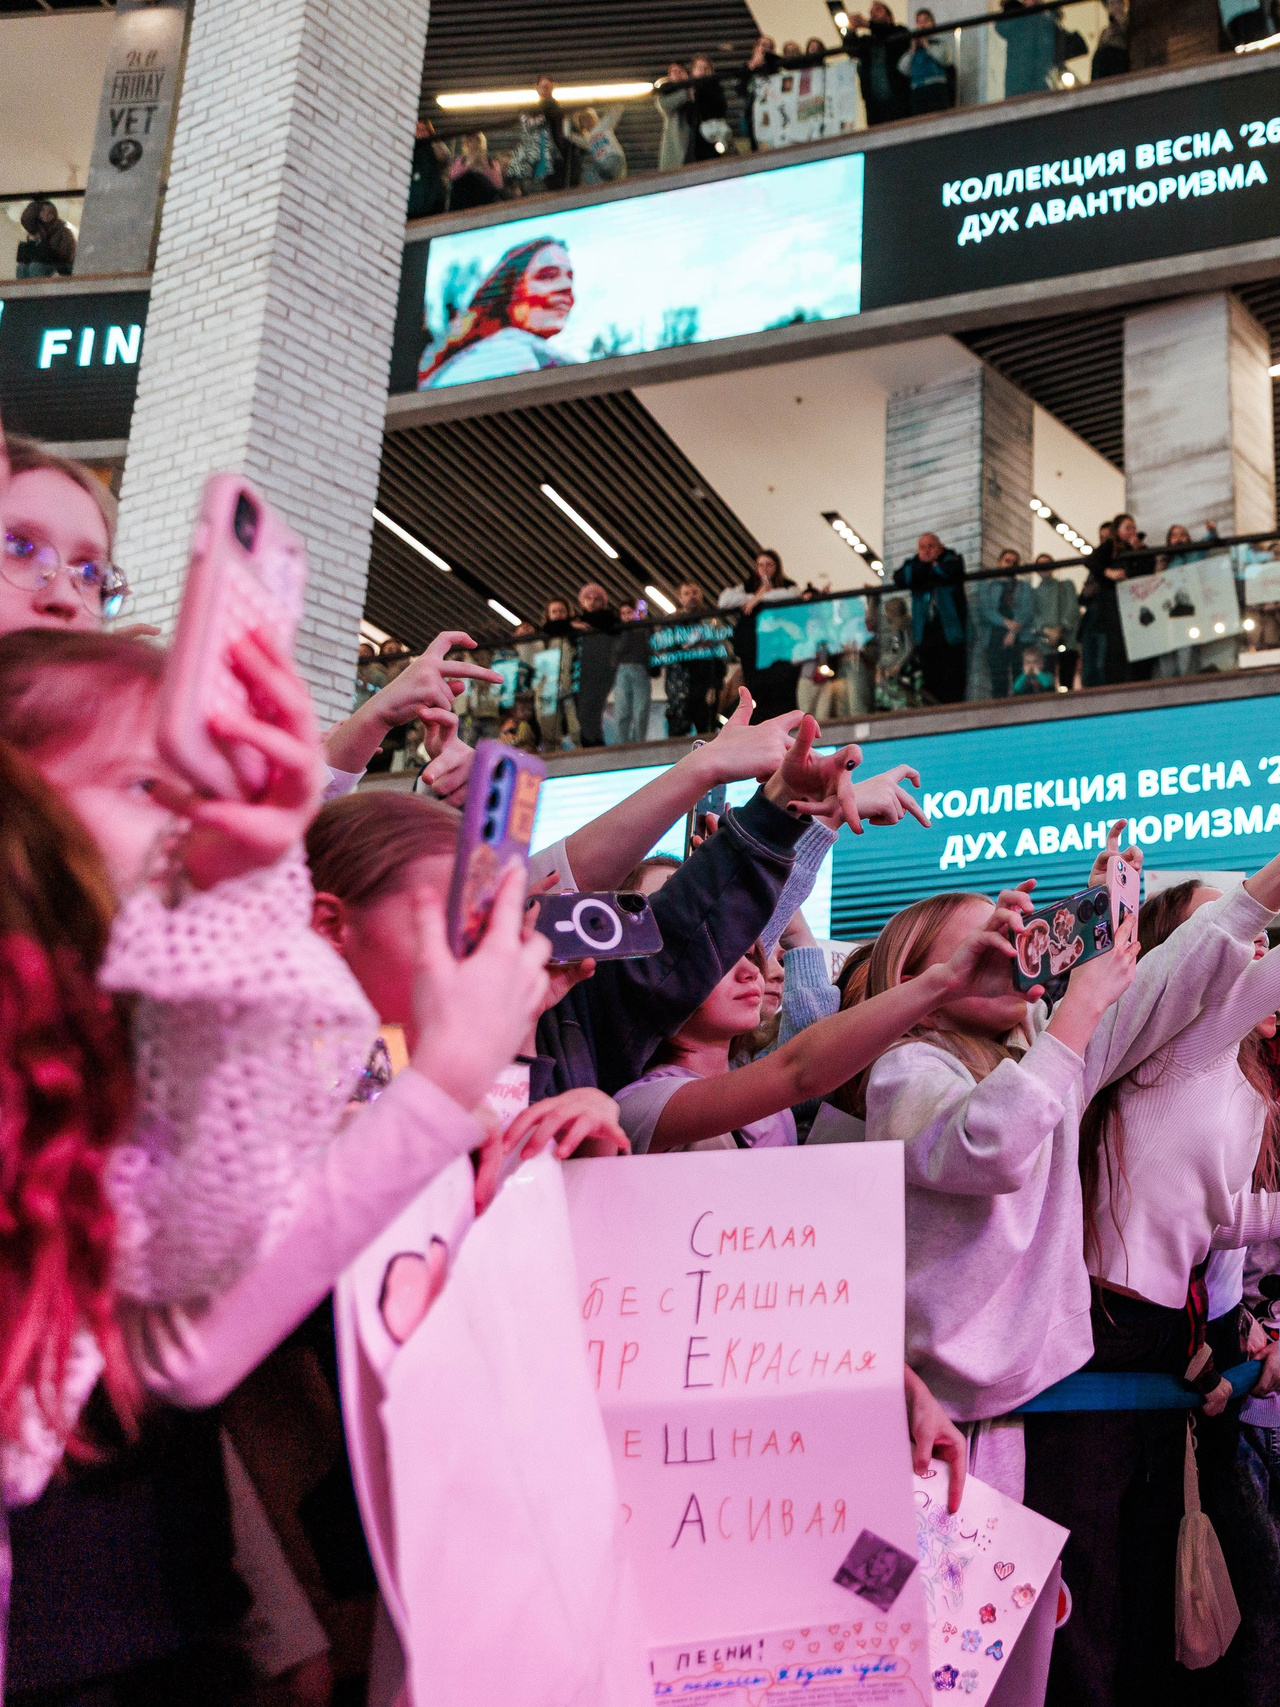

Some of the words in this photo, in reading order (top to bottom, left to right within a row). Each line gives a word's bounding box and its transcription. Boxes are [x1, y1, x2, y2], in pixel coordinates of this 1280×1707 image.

[942, 149, 1126, 207] КОЛЛЕКЦИЯ
[1135, 128, 1234, 170] ВЕСНА
[957, 206, 1019, 247] ДУХ
[1025, 160, 1268, 229] АВАНТЮРИЗМА
[922, 772, 1127, 821] КОЛЛЕКЦИЯ
[1137, 759, 1251, 799] ВЕСНА
[939, 831, 1007, 871] ДУХ
[690, 1211, 817, 1258] СМЕЛАЯ
[624, 1423, 805, 1465] ЕШНАЯ
